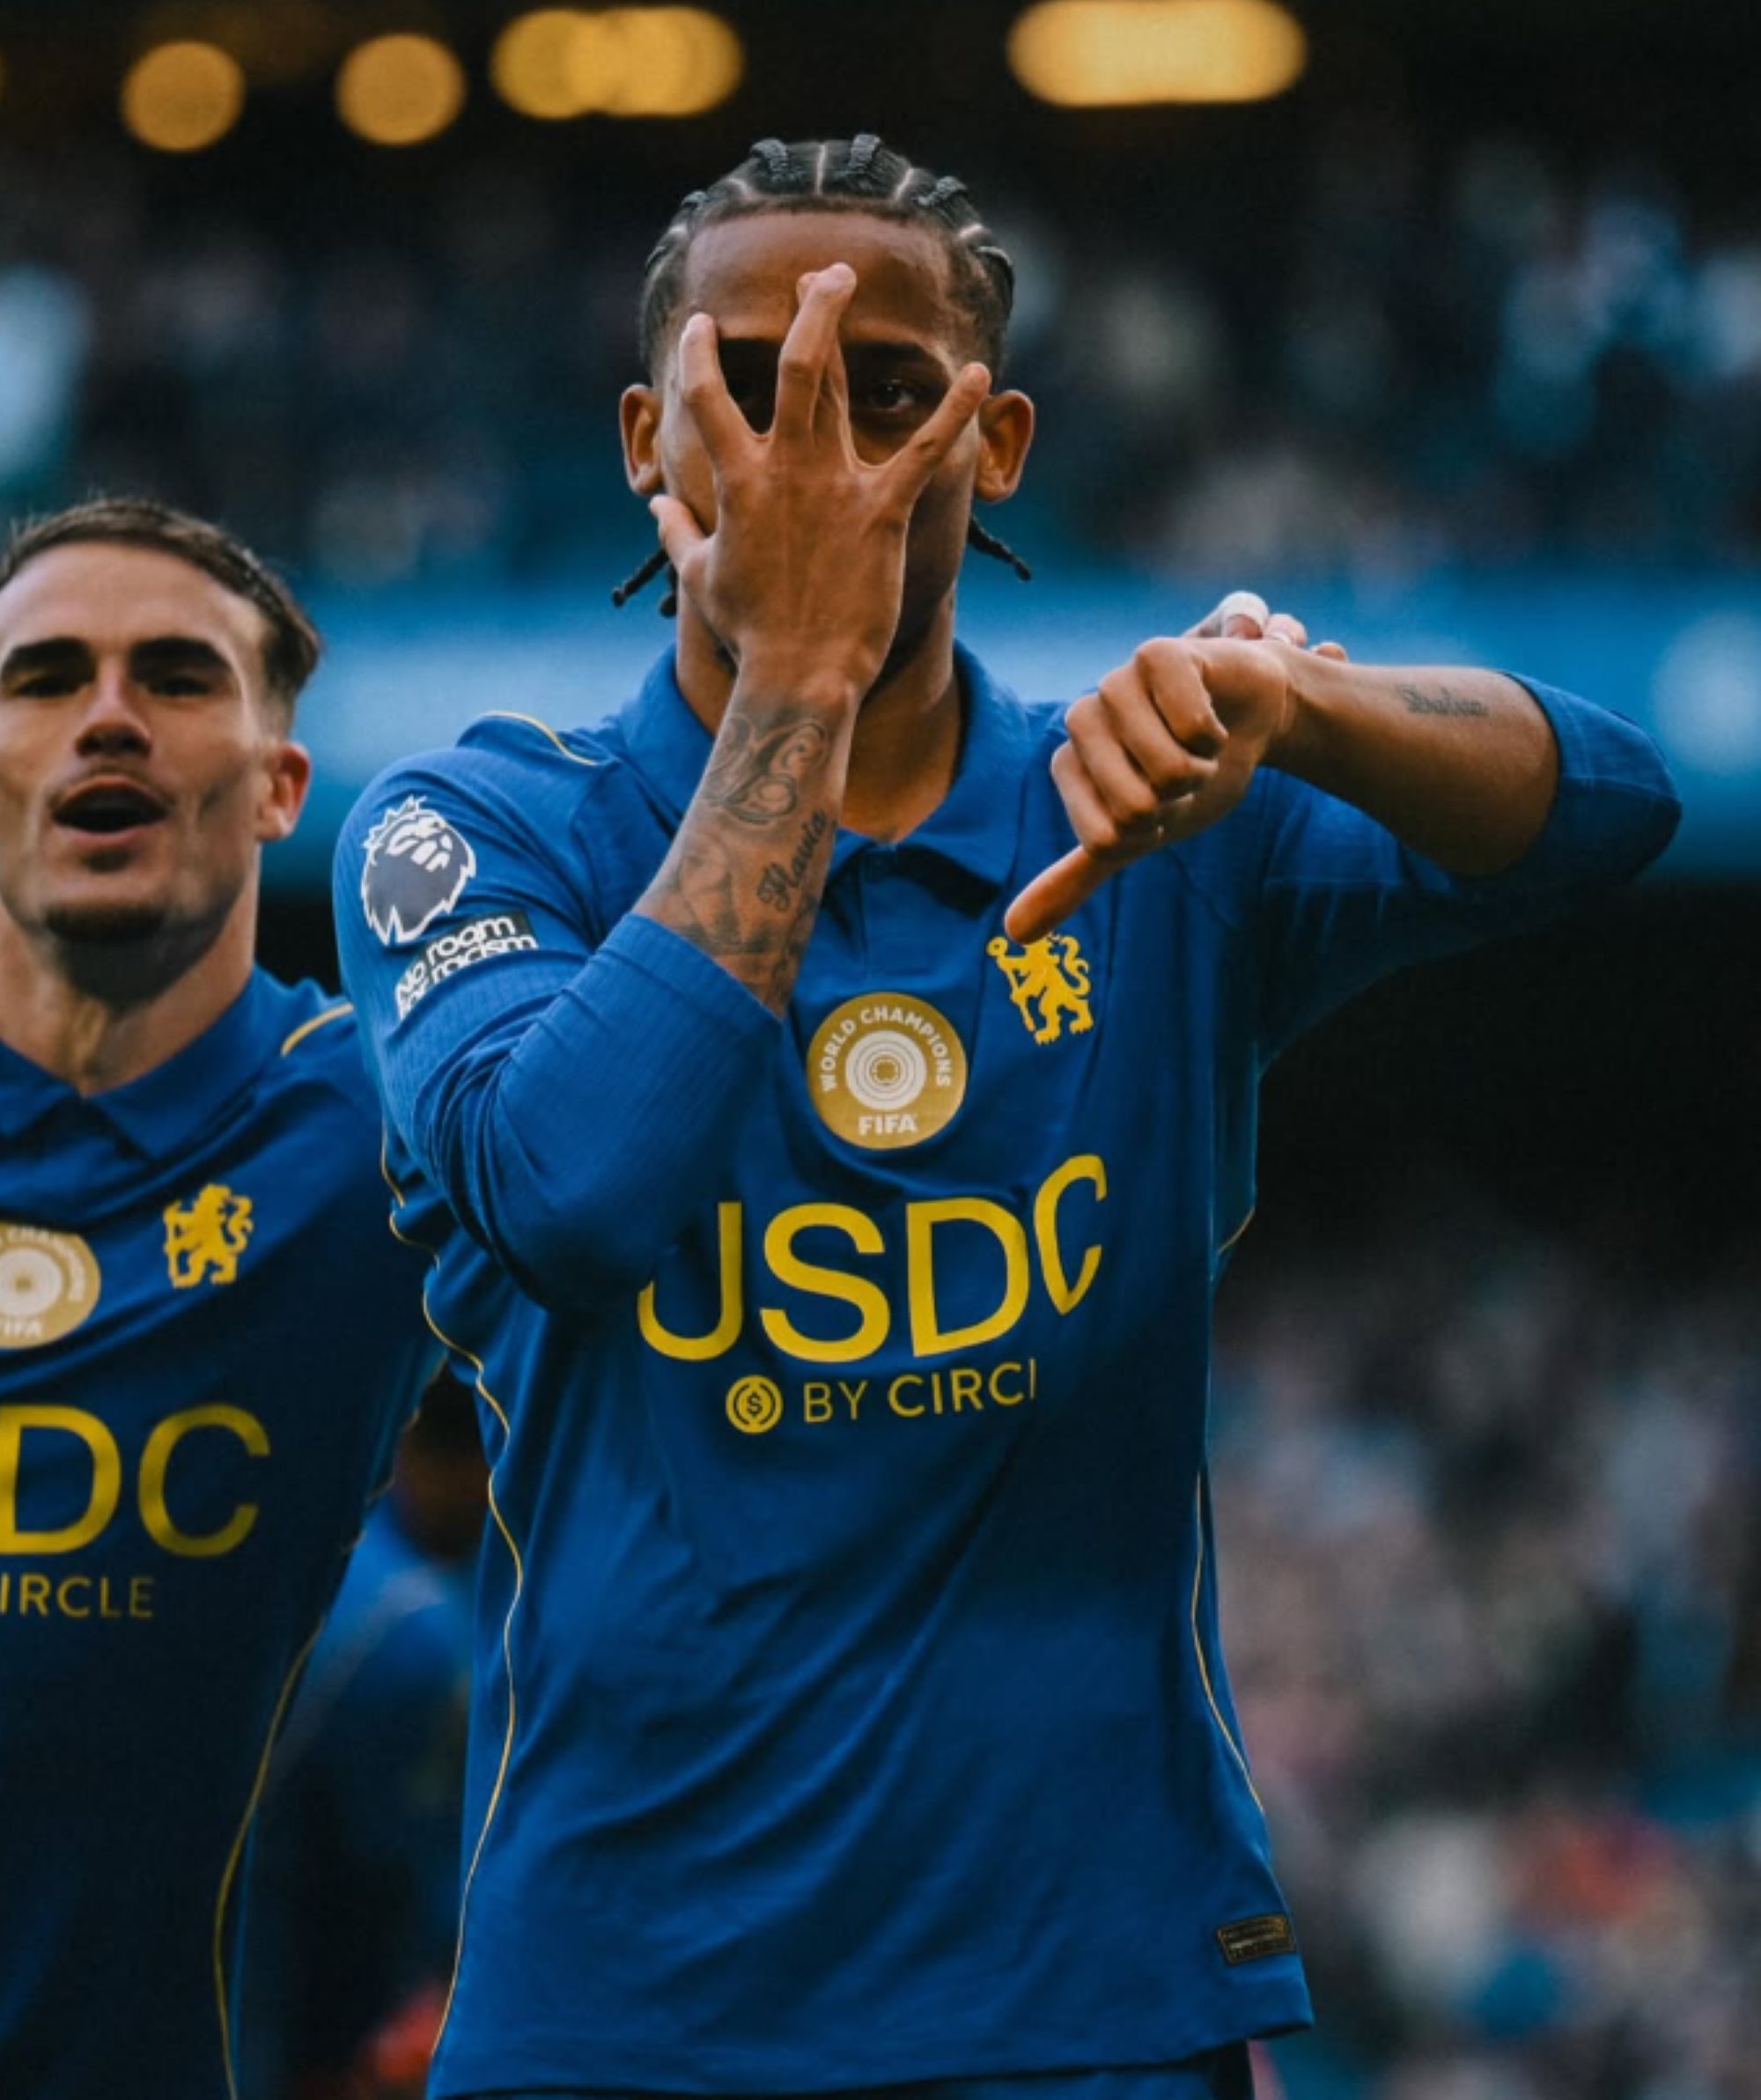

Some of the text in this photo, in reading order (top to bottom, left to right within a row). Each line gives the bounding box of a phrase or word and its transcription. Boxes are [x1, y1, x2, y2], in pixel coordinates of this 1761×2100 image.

[426, 916, 518, 966] room
[819, 1005, 953, 1093] WORLD CHAMPIONS
[858, 1112, 919, 1137] FIFA
[803, 1381, 869, 1424] BY
[0, 1403, 271, 1558] DC
[0, 1572, 153, 1619] IRCLE
